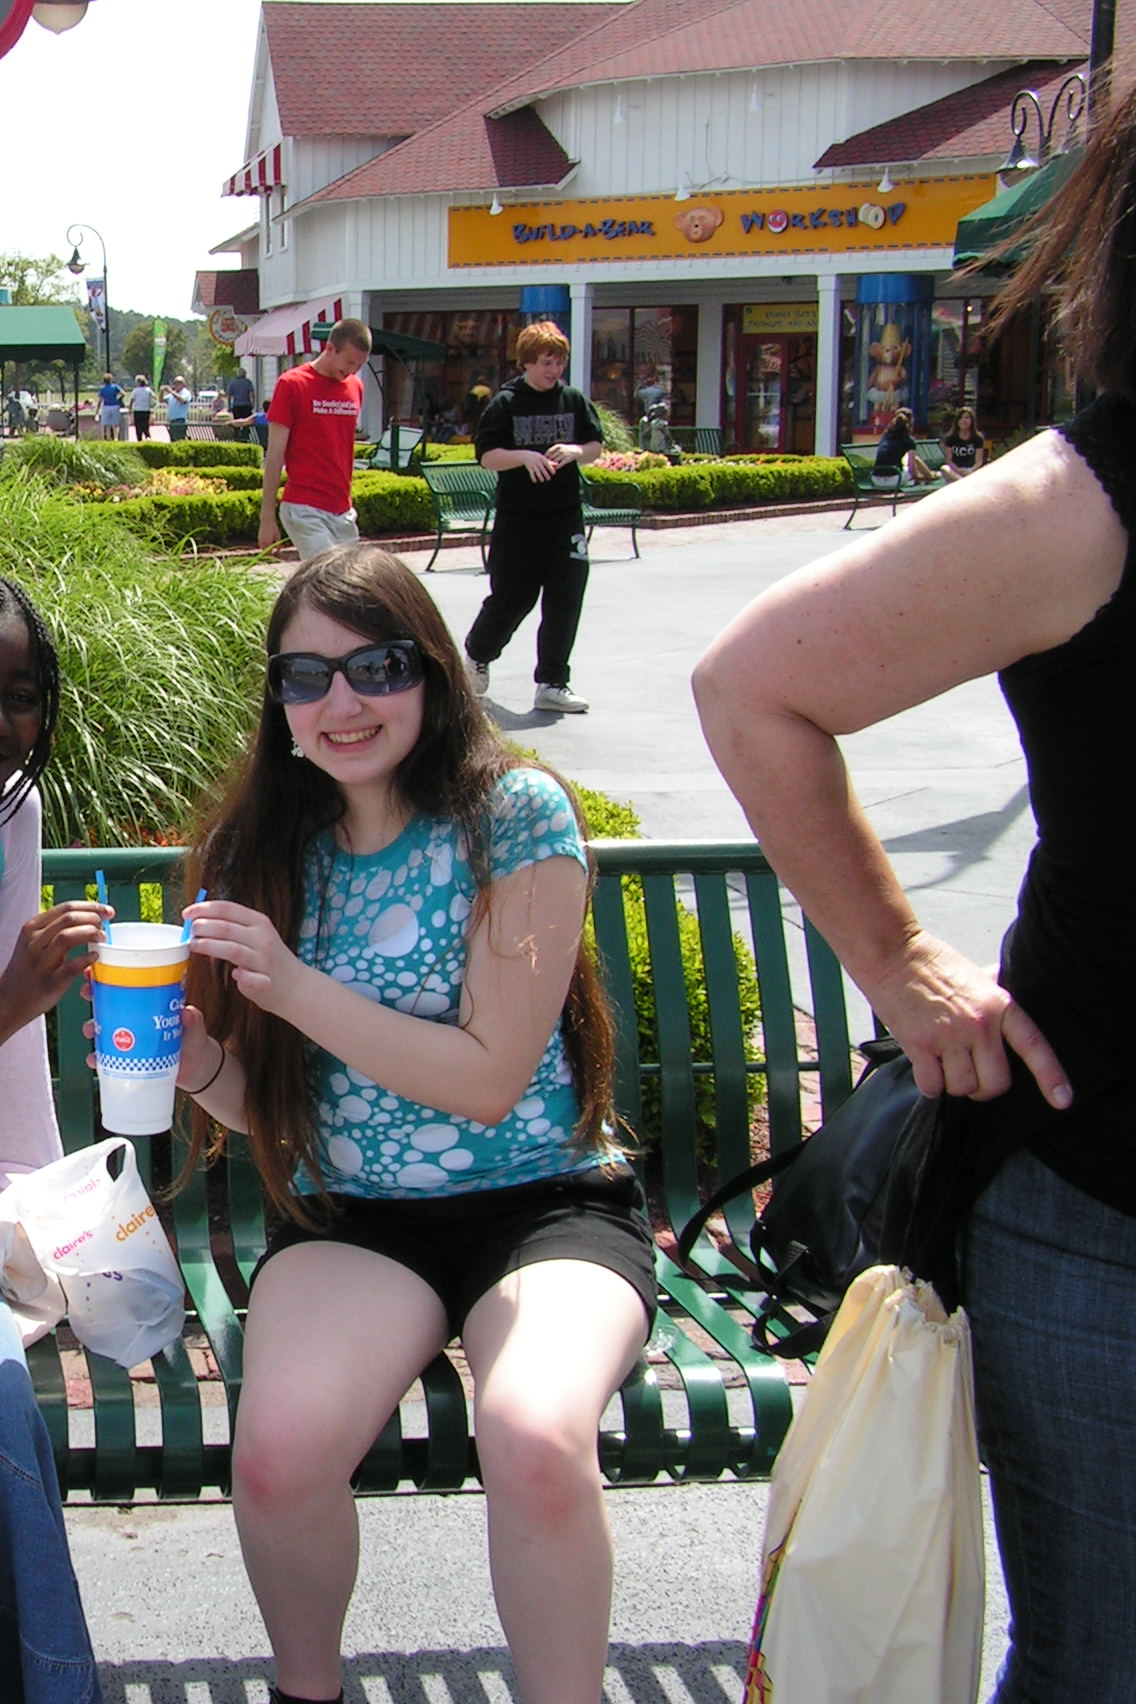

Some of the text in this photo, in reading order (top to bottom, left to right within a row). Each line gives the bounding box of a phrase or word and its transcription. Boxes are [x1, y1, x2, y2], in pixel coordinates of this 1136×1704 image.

[512, 202, 906, 244] BUILD-A-BEAR WORKSHOP
[52, 1230, 94, 1260] claire's
